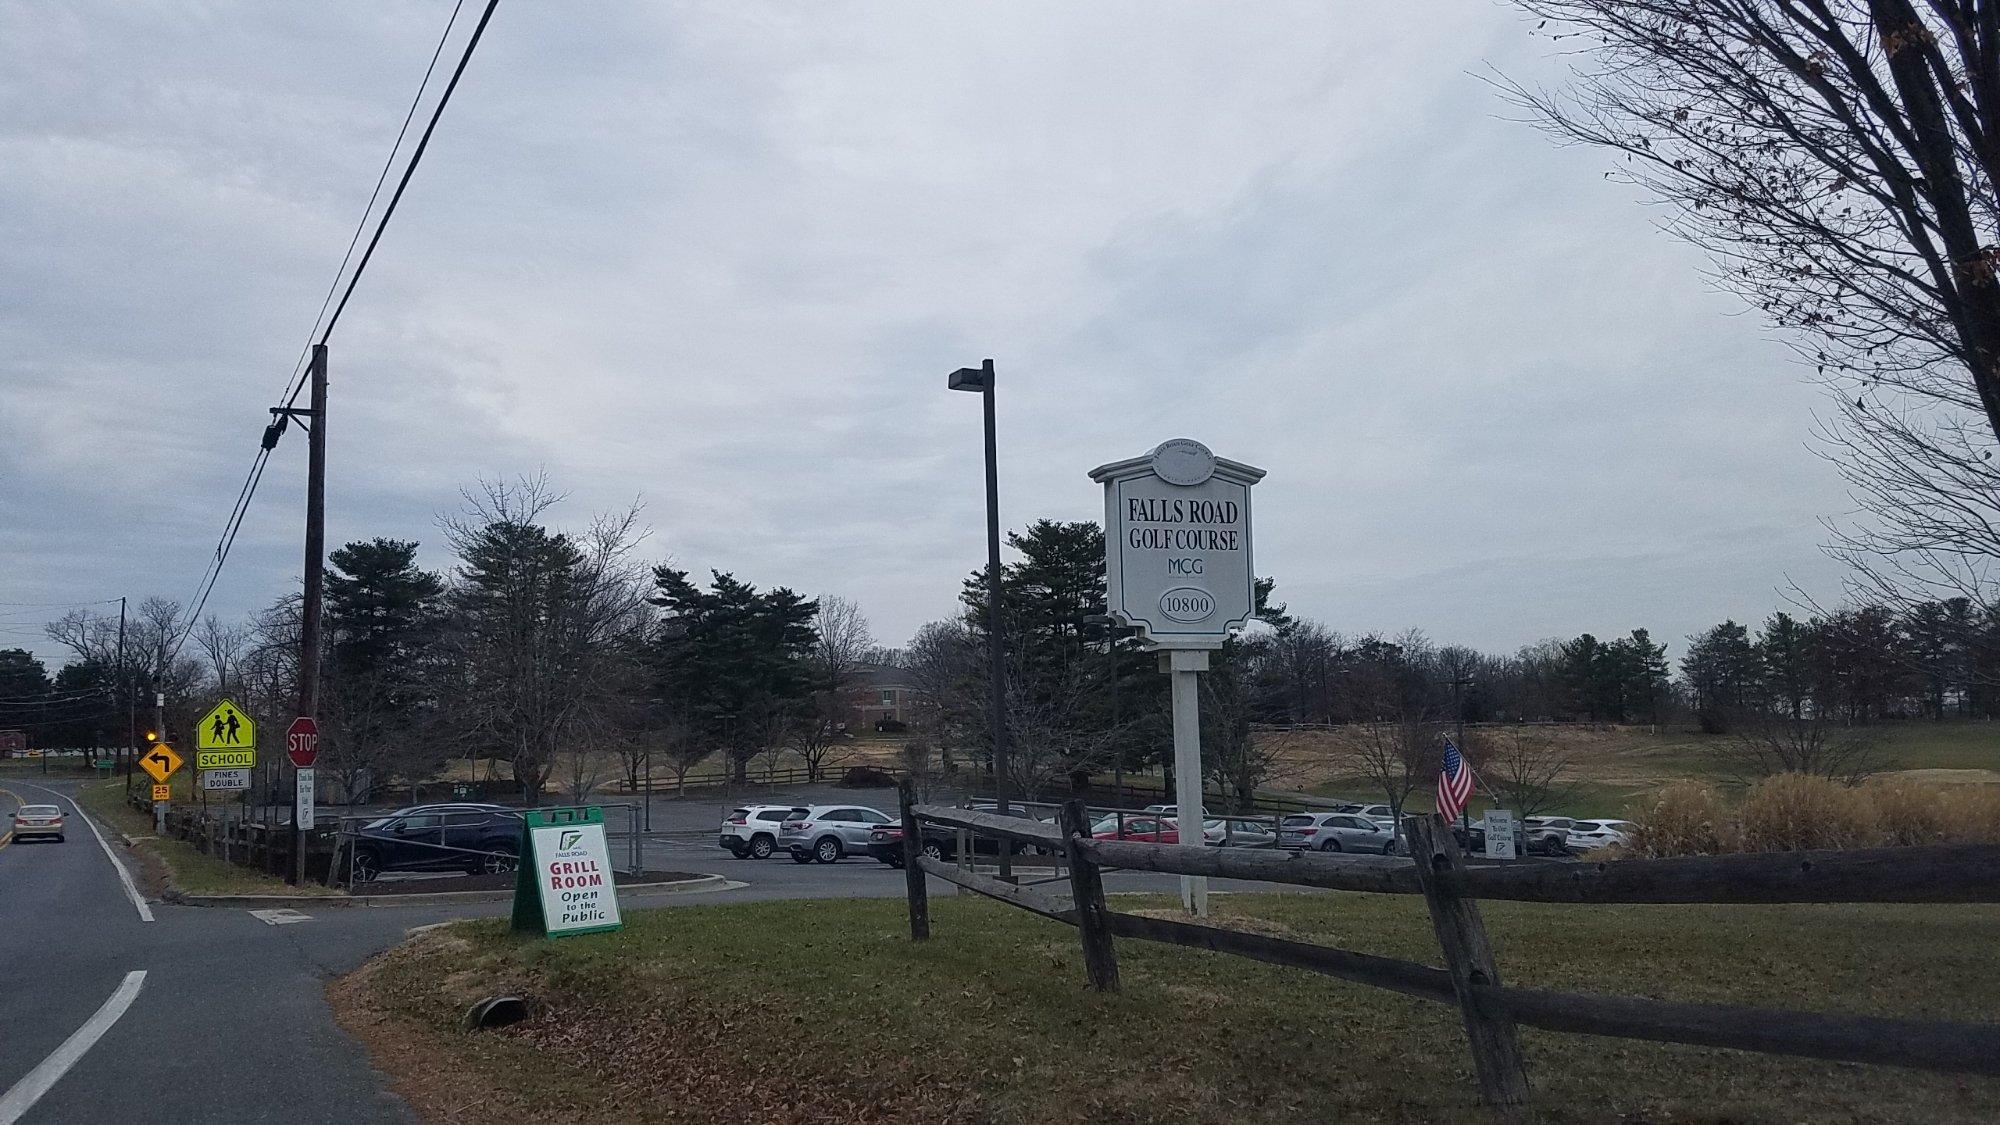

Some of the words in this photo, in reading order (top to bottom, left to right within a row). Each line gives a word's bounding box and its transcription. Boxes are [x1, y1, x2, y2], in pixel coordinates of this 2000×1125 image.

[1128, 498, 1184, 523] FALLS
[1189, 500, 1238, 524] ROAD
[1129, 528, 1174, 550] GOLF
[1175, 529, 1239, 551] COURSE
[1168, 558, 1203, 574] MCG
[1167, 597, 1209, 612] 10800
[289, 733, 318, 752] STOP
[201, 753, 251, 765] SCHOOL
[214, 771, 239, 779] FINES
[209, 779, 244, 787] DOUBLE
[155, 786, 168, 794] 25
[550, 861, 599, 875] GRILL
[551, 874, 603, 890] ROOM
[561, 891, 598, 903] Open
[566, 903, 576, 911] to
[580, 901, 596, 909] the
[562, 910, 605, 923] Public
